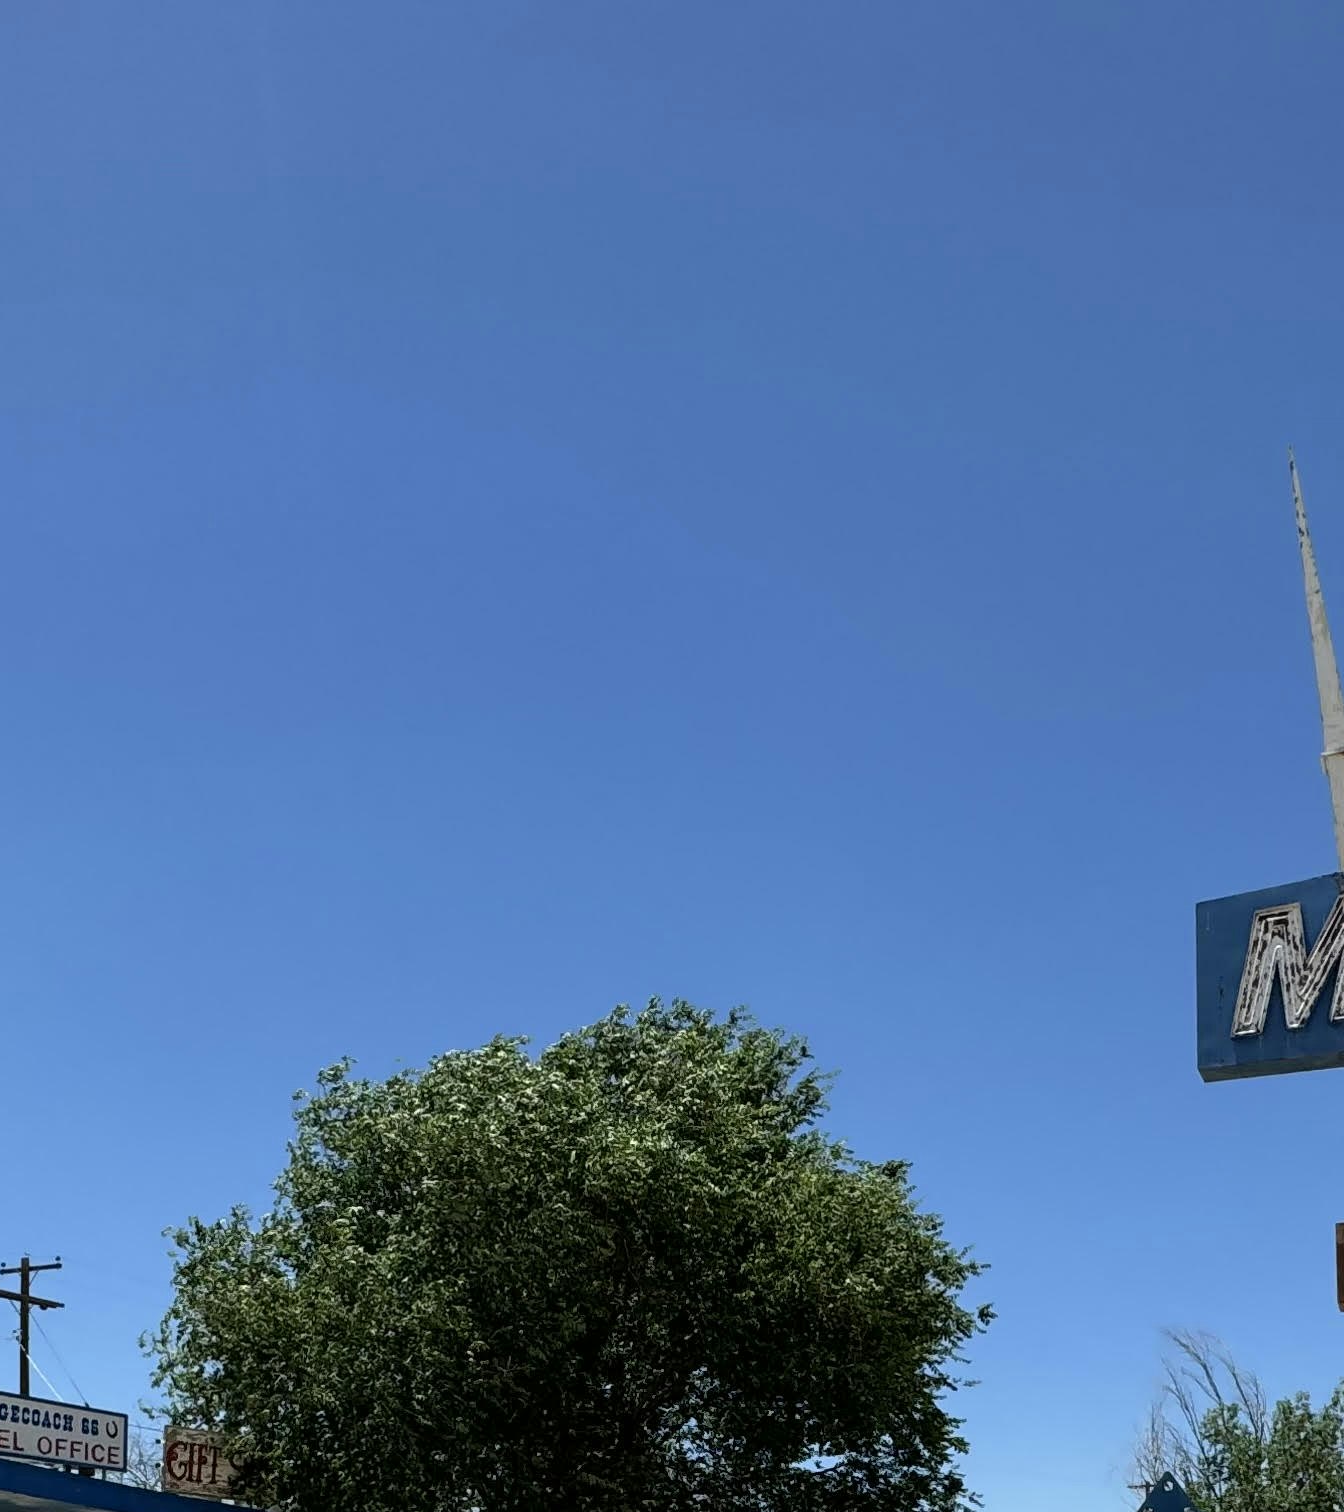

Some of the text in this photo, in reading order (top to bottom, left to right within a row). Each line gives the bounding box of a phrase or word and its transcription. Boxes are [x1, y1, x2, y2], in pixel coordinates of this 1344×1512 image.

[81, 1416, 100, 1436] 66
[37, 1436, 121, 1465] OFFICE
[166, 1439, 222, 1485] GIFT
